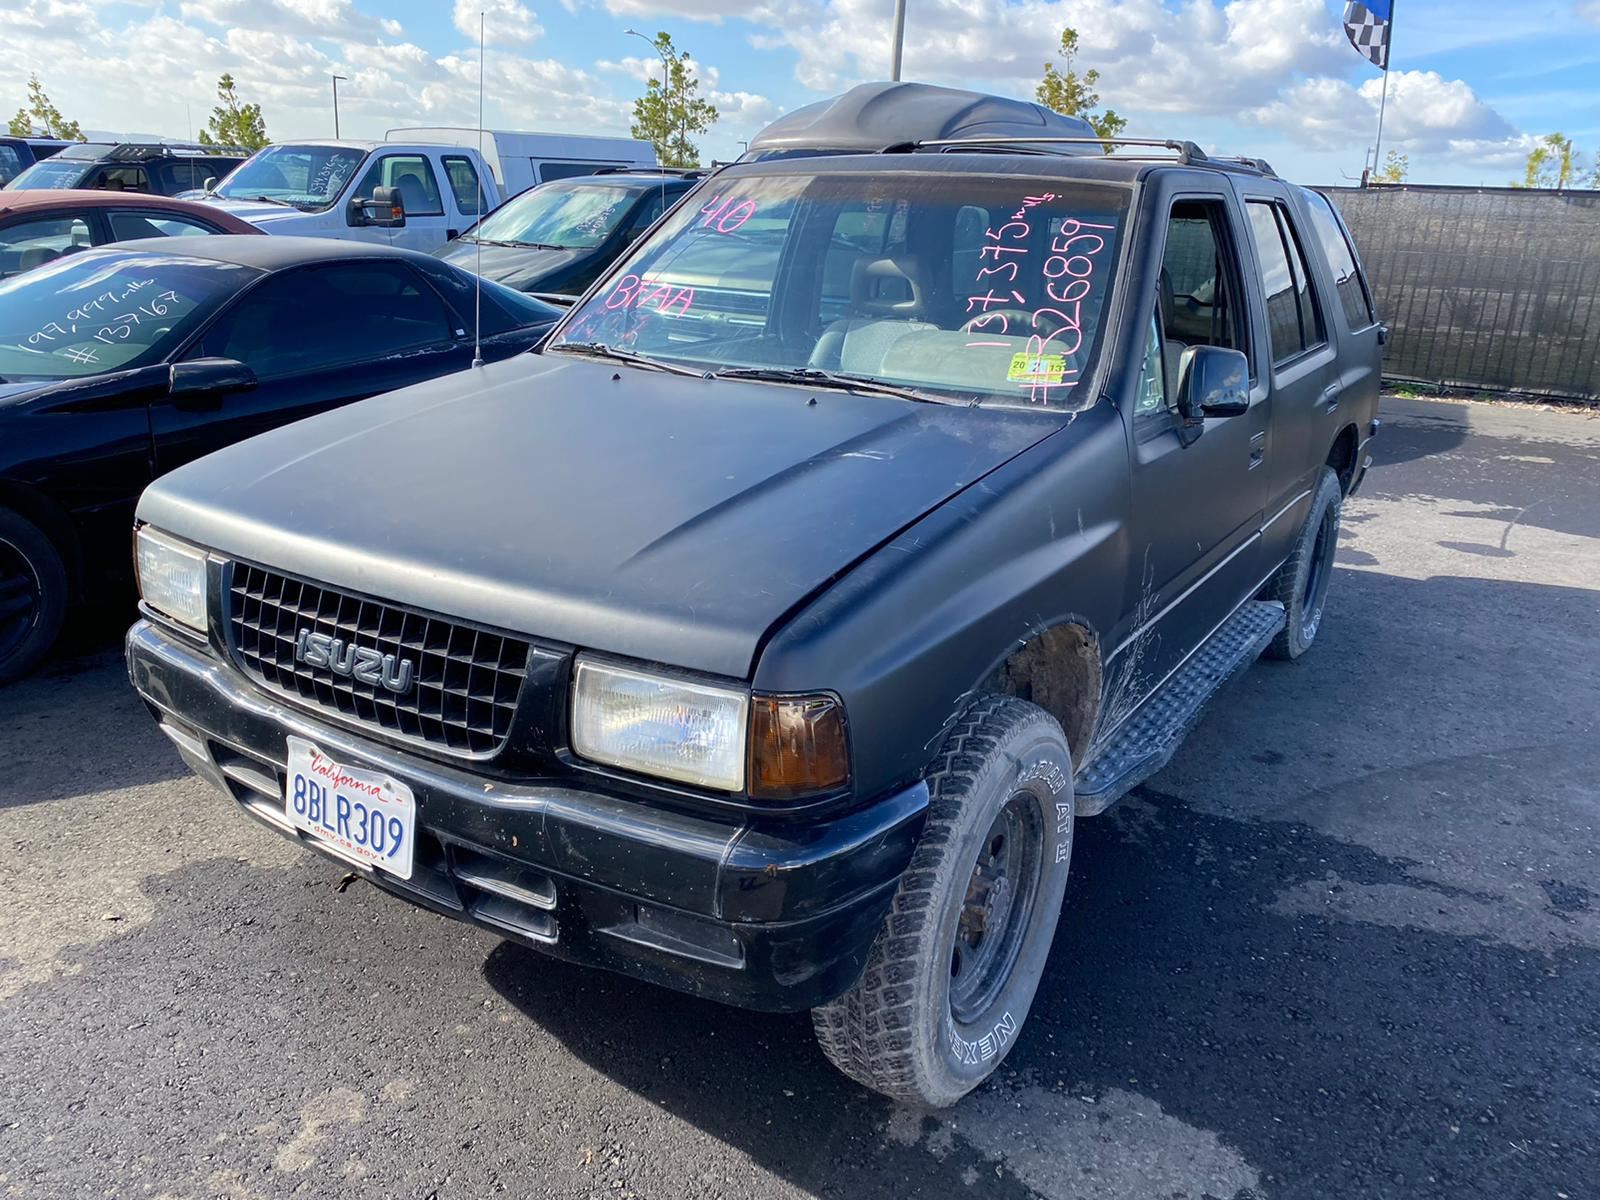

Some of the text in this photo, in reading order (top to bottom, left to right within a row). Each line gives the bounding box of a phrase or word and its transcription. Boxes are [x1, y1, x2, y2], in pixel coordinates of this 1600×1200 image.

[17, 291, 119, 354] 197,999
[1012, 360, 1025, 370] 20
[1049, 364, 1062, 373] 13
[296, 627, 414, 695] ISUZU
[310, 753, 389, 803] California
[293, 773, 404, 858] 8BLR309
[1055, 803, 1071, 833] AT
